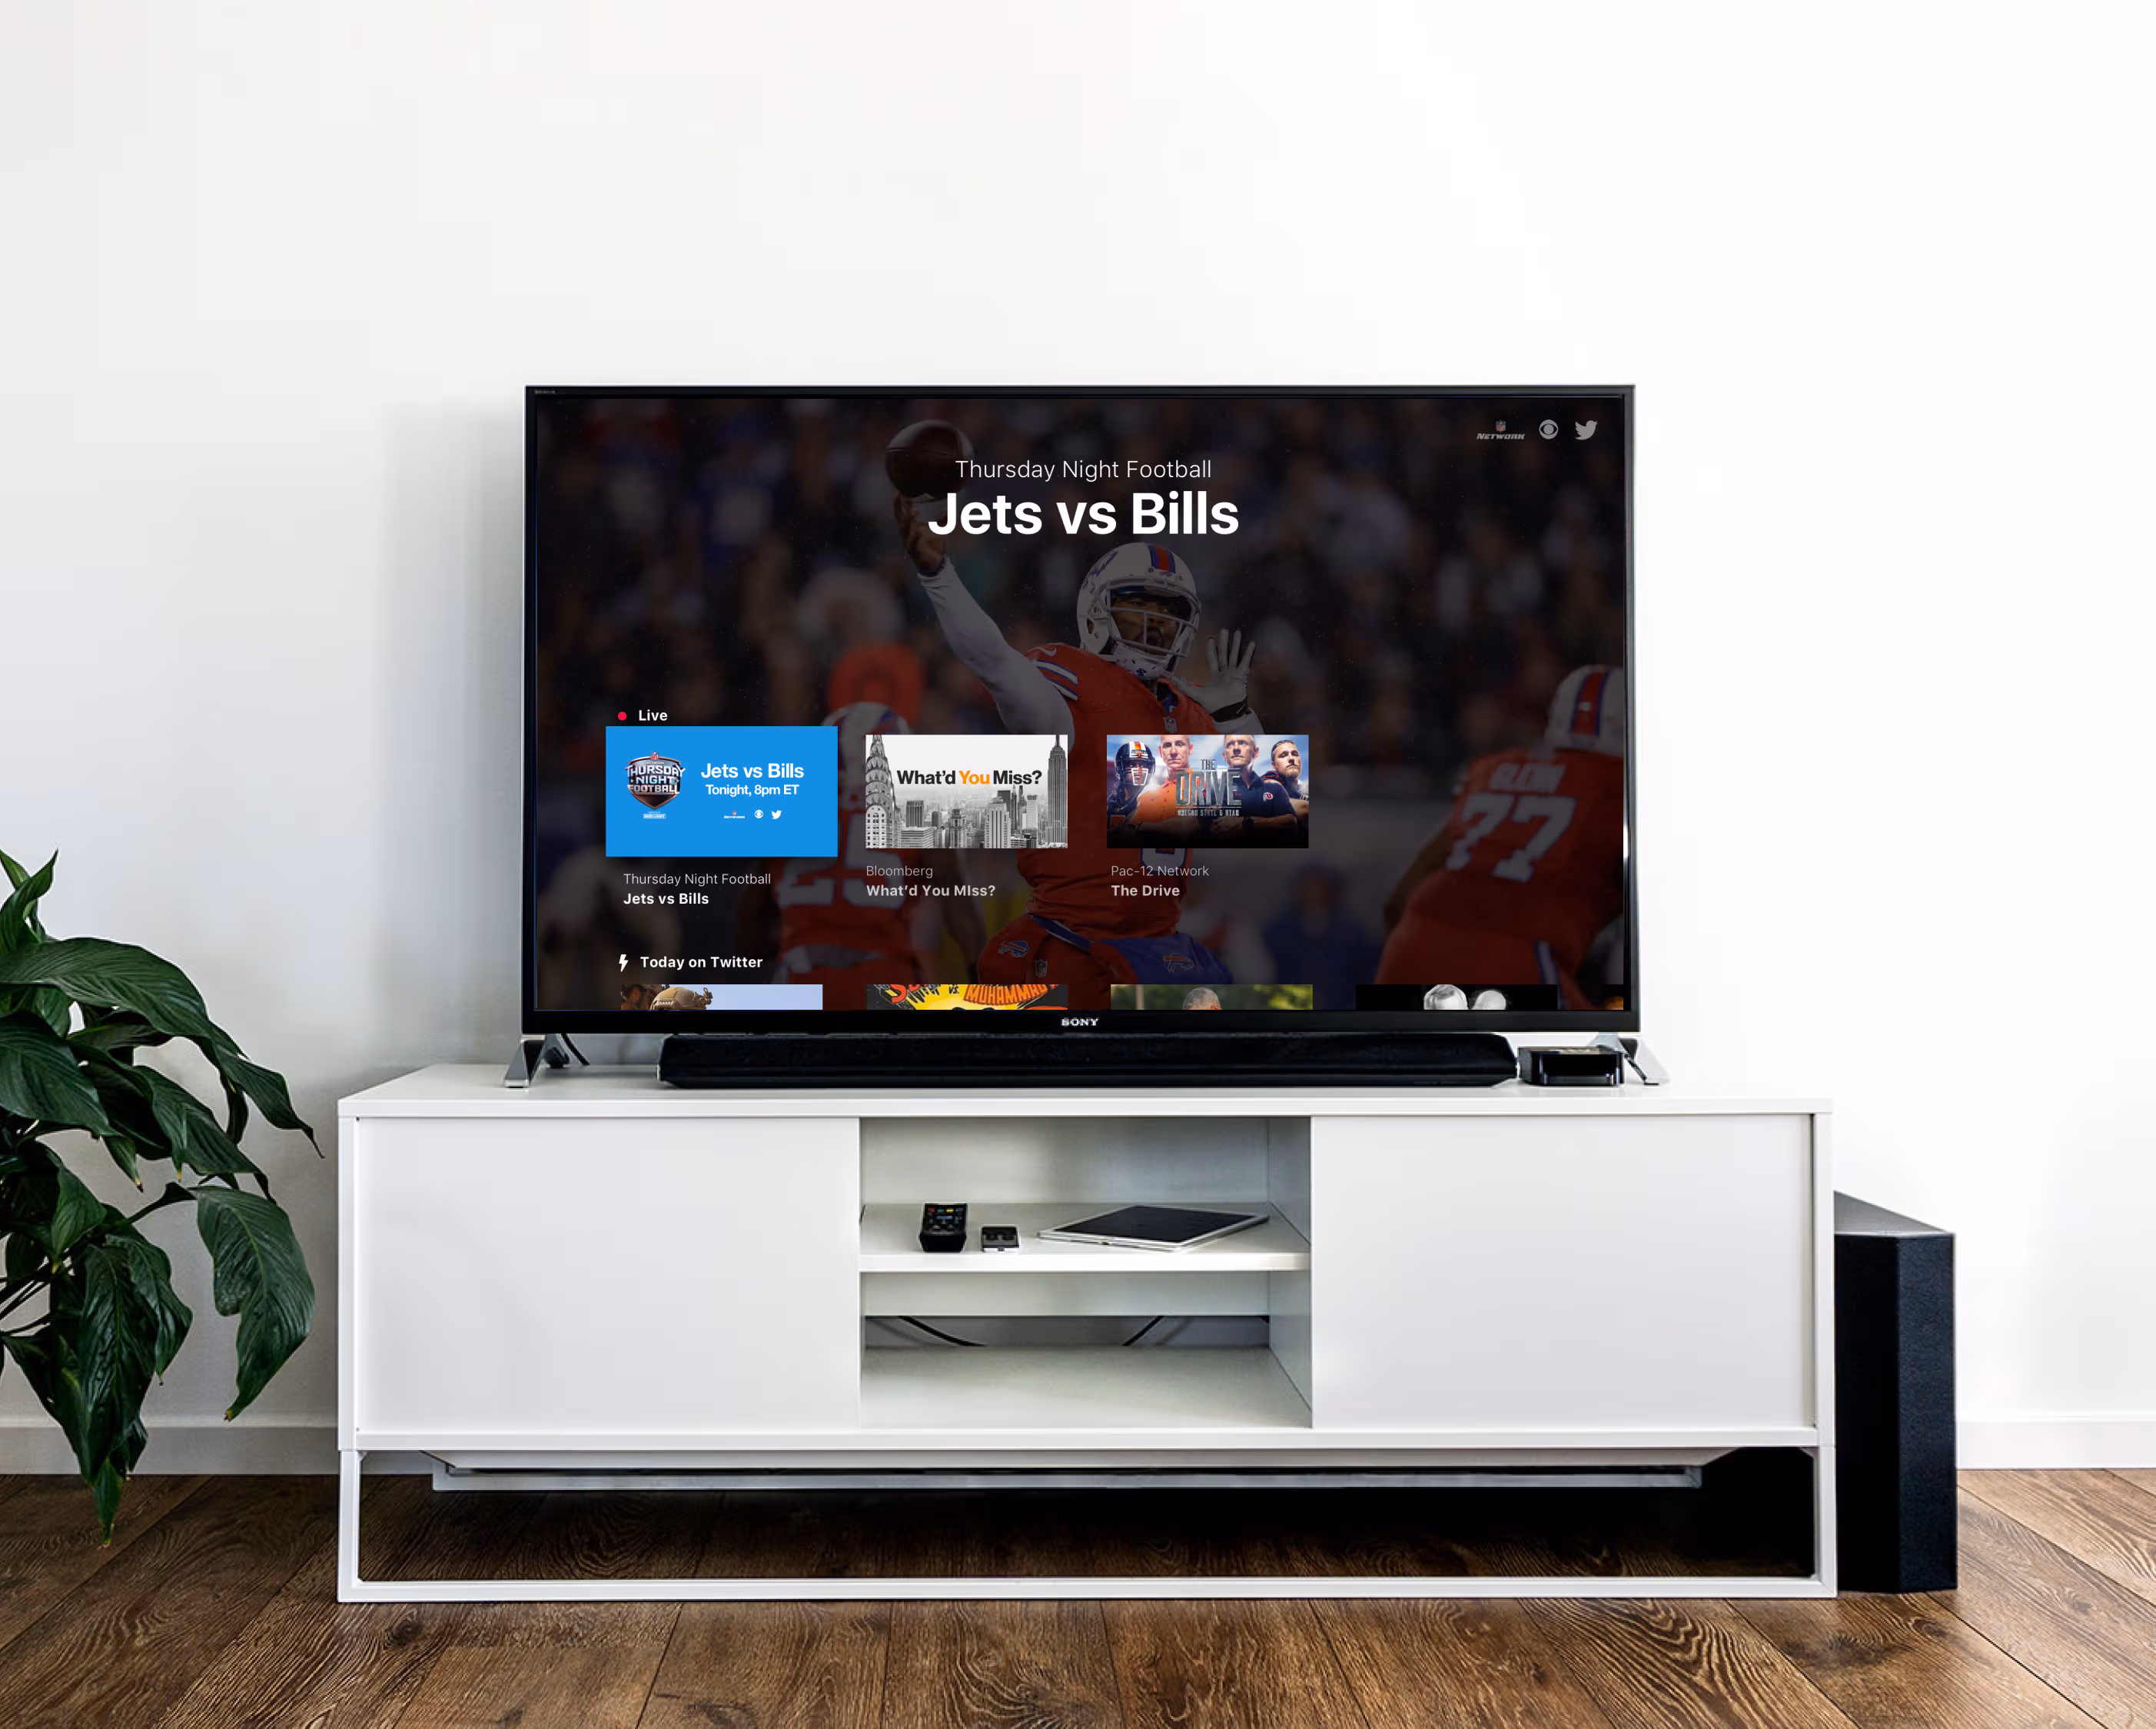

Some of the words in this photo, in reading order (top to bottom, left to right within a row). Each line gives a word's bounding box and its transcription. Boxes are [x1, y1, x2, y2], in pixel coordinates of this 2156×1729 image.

[955, 460, 1055, 482] Thursday
[1064, 460, 1118, 482] Night
[1128, 460, 1211, 478] Football
[928, 493, 1042, 535] Jets
[1056, 502, 1117, 535] vs
[1132, 490, 1239, 535] Bills
[639, 709, 668, 722] Live
[701, 763, 739, 778] Jets
[743, 766, 762, 778] vs
[768, 763, 804, 778] Bills
[1201, 758, 1216, 771] THE
[624, 765, 686, 778] THURSDAY
[958, 770, 989, 785] You
[993, 770, 1042, 785] Miss?
[636, 775, 673, 784] NIGHT
[626, 785, 679, 794] FOOTBALL
[706, 785, 752, 797] Tonight,
[754, 785, 781, 797] 8pm
[783, 785, 799, 795] ET
[1175, 769, 1241, 805] DRIVE
[1446, 791, 1576, 882] 77
[866, 865, 933, 879] Bloomberg
[1111, 865, 1154, 876] Pac-12
[1158, 865, 1209, 876] Network
[623, 873, 681, 887] Thursday
[685, 873, 718, 887] Night
[722, 873, 771, 884] Football
[922, 884, 949, 897] You
[1111, 884, 1138, 896] The
[1142, 884, 1180, 896] Drive
[623, 893, 655, 904] Jets
[658, 895, 675, 904] vs
[679, 892, 709, 904] Bills
[640, 956, 685, 971] Today
[688, 958, 706, 968] on
[710, 955, 763, 968] Twitter
[1061, 1017, 1098, 1027] SONY
